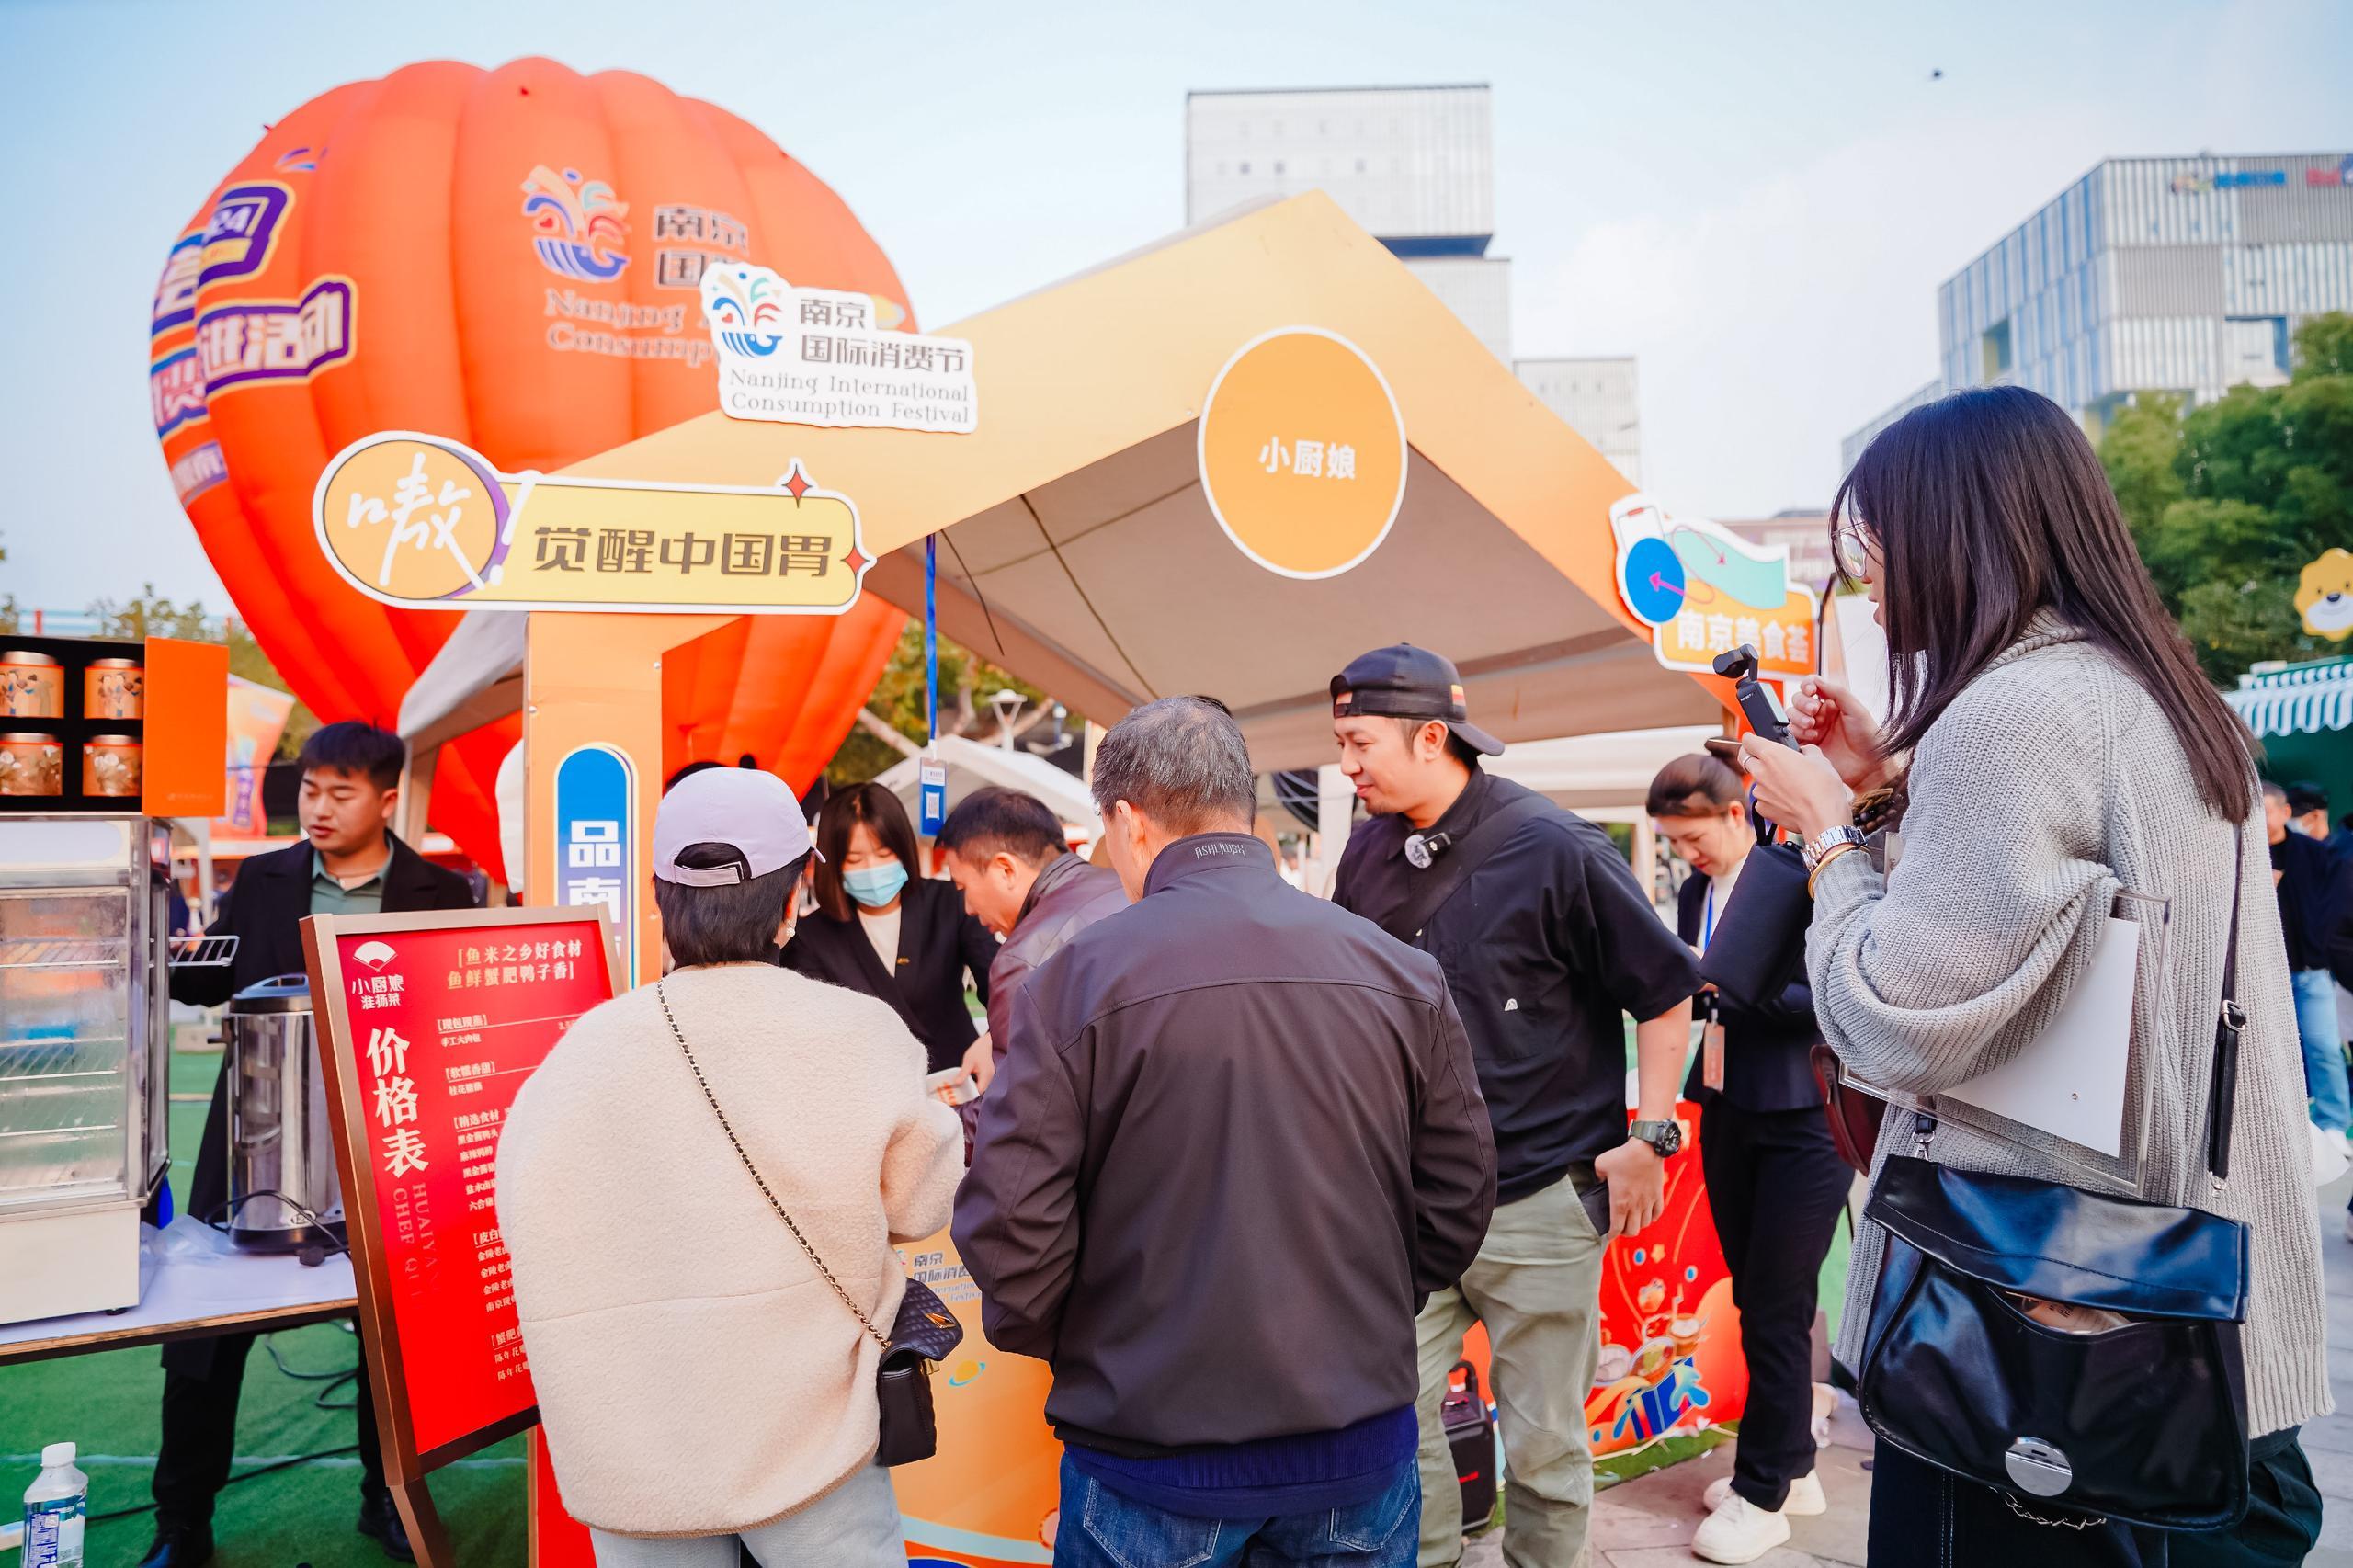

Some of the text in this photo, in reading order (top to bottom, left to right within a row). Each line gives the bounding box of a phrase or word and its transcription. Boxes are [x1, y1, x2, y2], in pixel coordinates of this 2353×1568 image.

[655, 206, 748, 253] 南京
[546, 290, 685, 331] Nanjing
[800, 299, 867, 329] 南京
[549, 324, 720, 365] Consump
[801, 335, 965, 373] 国际消费节
[730, 369, 969, 402] Nanjing International
[732, 392, 969, 423] Consumption Festival
[1258, 436, 1356, 480] 小厨娘
[533, 527, 832, 577] 觉醒中国胃
[351, 973, 405, 994] 小厨娘
[361, 993, 402, 1009] 淮扬菜
[366, 1026, 430, 1178] 价格表
[914, 1252, 943, 1268] 南京
